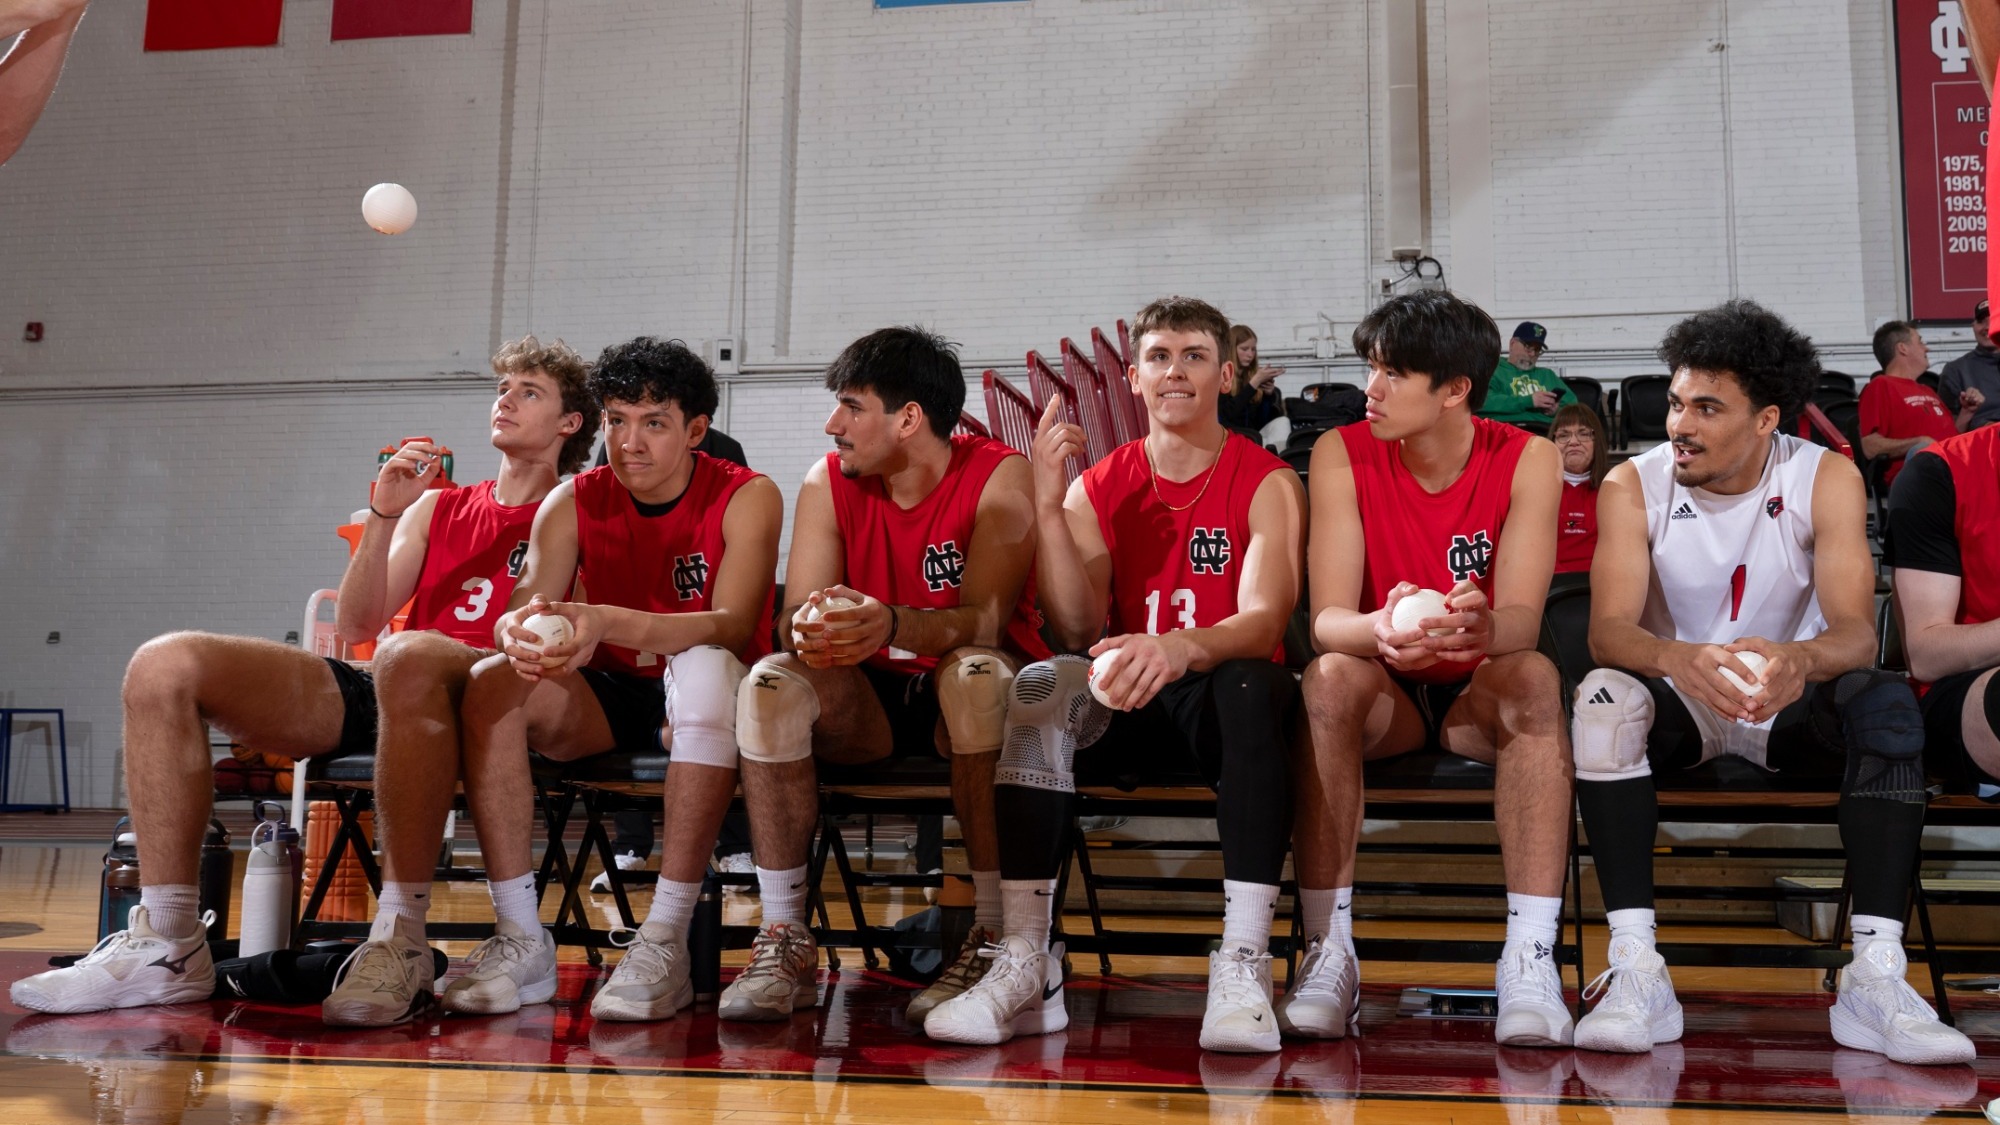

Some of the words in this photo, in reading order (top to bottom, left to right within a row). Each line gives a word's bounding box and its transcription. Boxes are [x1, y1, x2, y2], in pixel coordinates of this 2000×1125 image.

[1957, 106, 1991, 123] ME
[1943, 154, 1985, 172] 1975,
[1944, 175, 1985, 193] 1981,
[1944, 195, 1987, 213] 1993,
[1947, 215, 1987, 232] 2009
[1948, 236, 1987, 253] 2016
[1671, 512, 1697, 520] adidas
[453, 576, 494, 622] 3
[1729, 563, 1747, 622] 1
[1145, 588, 1196, 637] 13
[1237, 946, 1256, 957] NIKE
